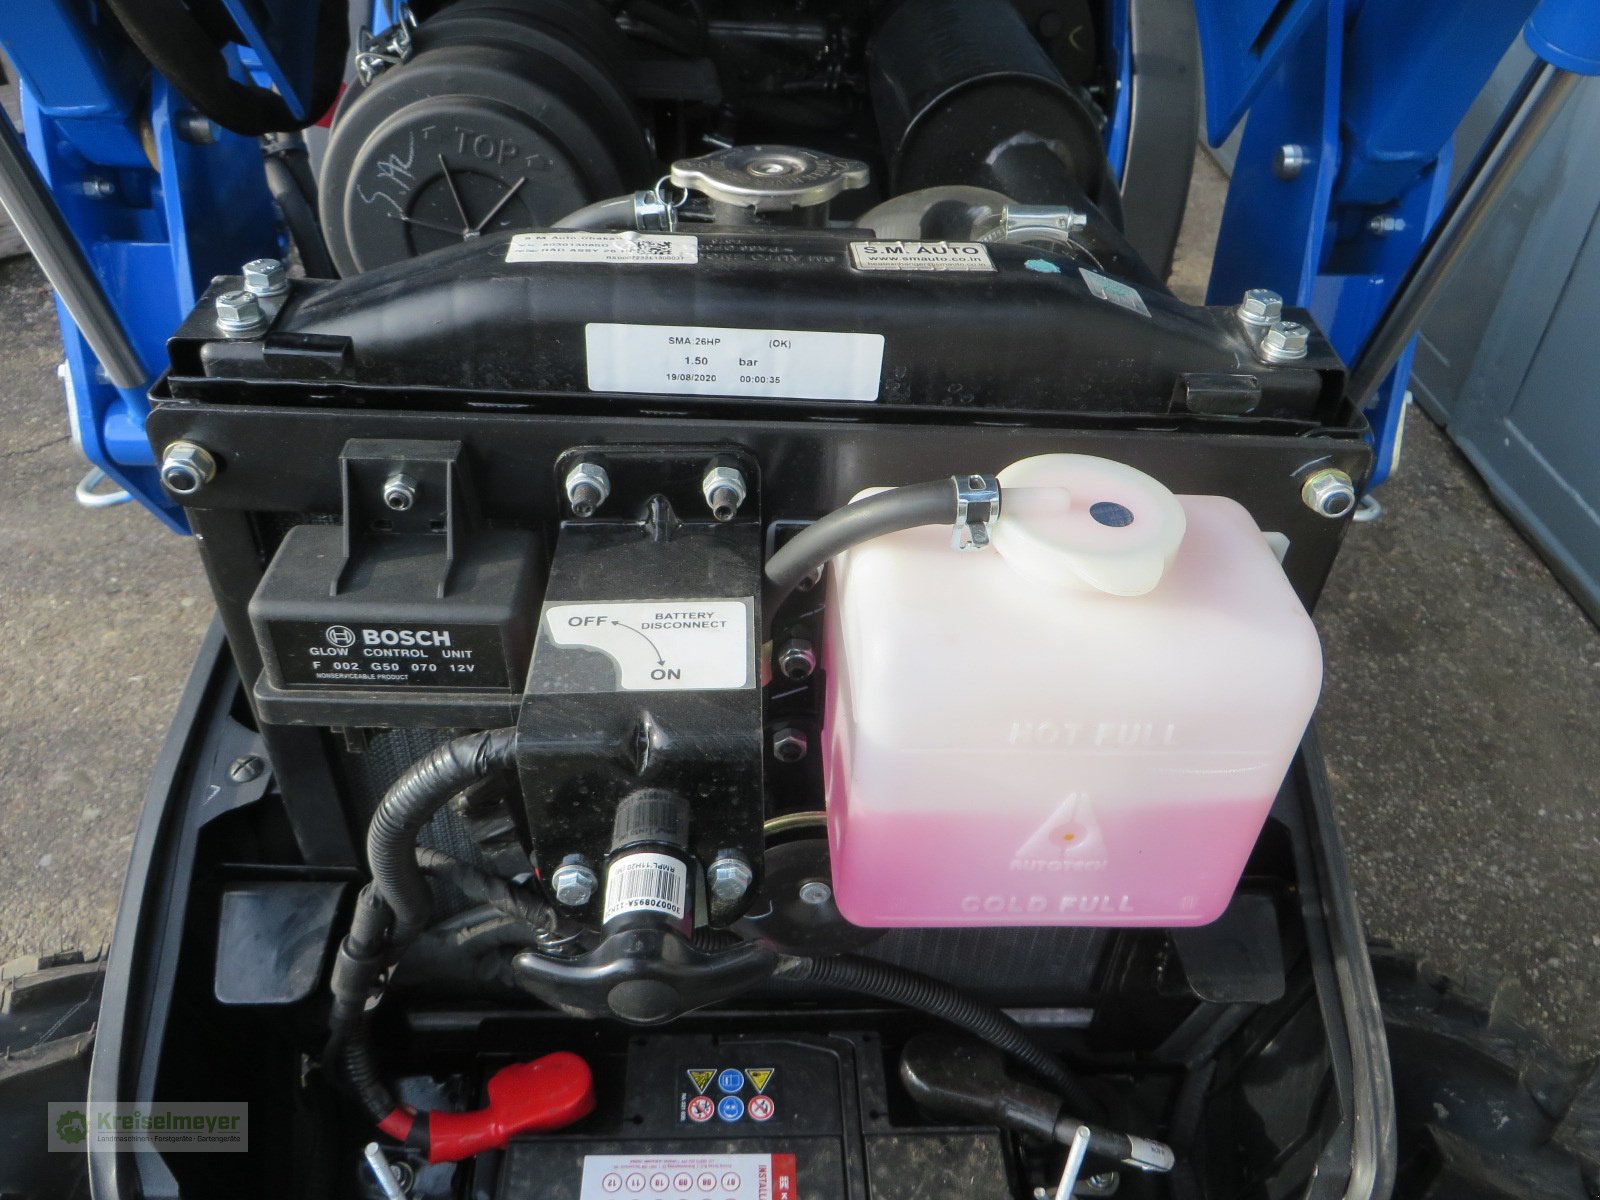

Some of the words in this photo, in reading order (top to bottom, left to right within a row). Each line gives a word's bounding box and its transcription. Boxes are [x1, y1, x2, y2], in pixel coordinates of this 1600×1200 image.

[454, 125, 516, 164] TOP
[917, 246, 979, 255] AUTO
[768, 339, 792, 349] (OK)
[685, 356, 708, 365] 1.50
[738, 357, 758, 367] bar
[666, 373, 717, 382] 19/08/2020
[739, 375, 781, 384] 00:00:35
[568, 615, 609, 627] OFF
[655, 611, 715, 620] BATTERY
[641, 620, 728, 630] DISCONNECT
[361, 629, 452, 647] BOSCH
[309, 647, 349, 656] GLOW
[363, 648, 429, 658] CONTROL
[441, 650, 473, 659] UNIT
[312, 661, 321, 670] F
[333, 662, 360, 670] 002
[371, 662, 400, 671] G50
[410, 663, 437, 672] 070
[450, 664, 475, 673] 12V
[316, 672, 376, 680] NONSERVICEABLE
[650, 668, 681, 681] ON
[1008, 720, 1082, 745] HOT
[1094, 721, 1179, 746] FULL
[960, 894, 1048, 913] COLD
[1057, 894, 1135, 913] FULL
[607, 1179, 616, 1187] 12
[631, 1179, 640, 1187] 11
[655, 1179, 664, 1187] 10
[726, 1178, 736, 1187] 07
